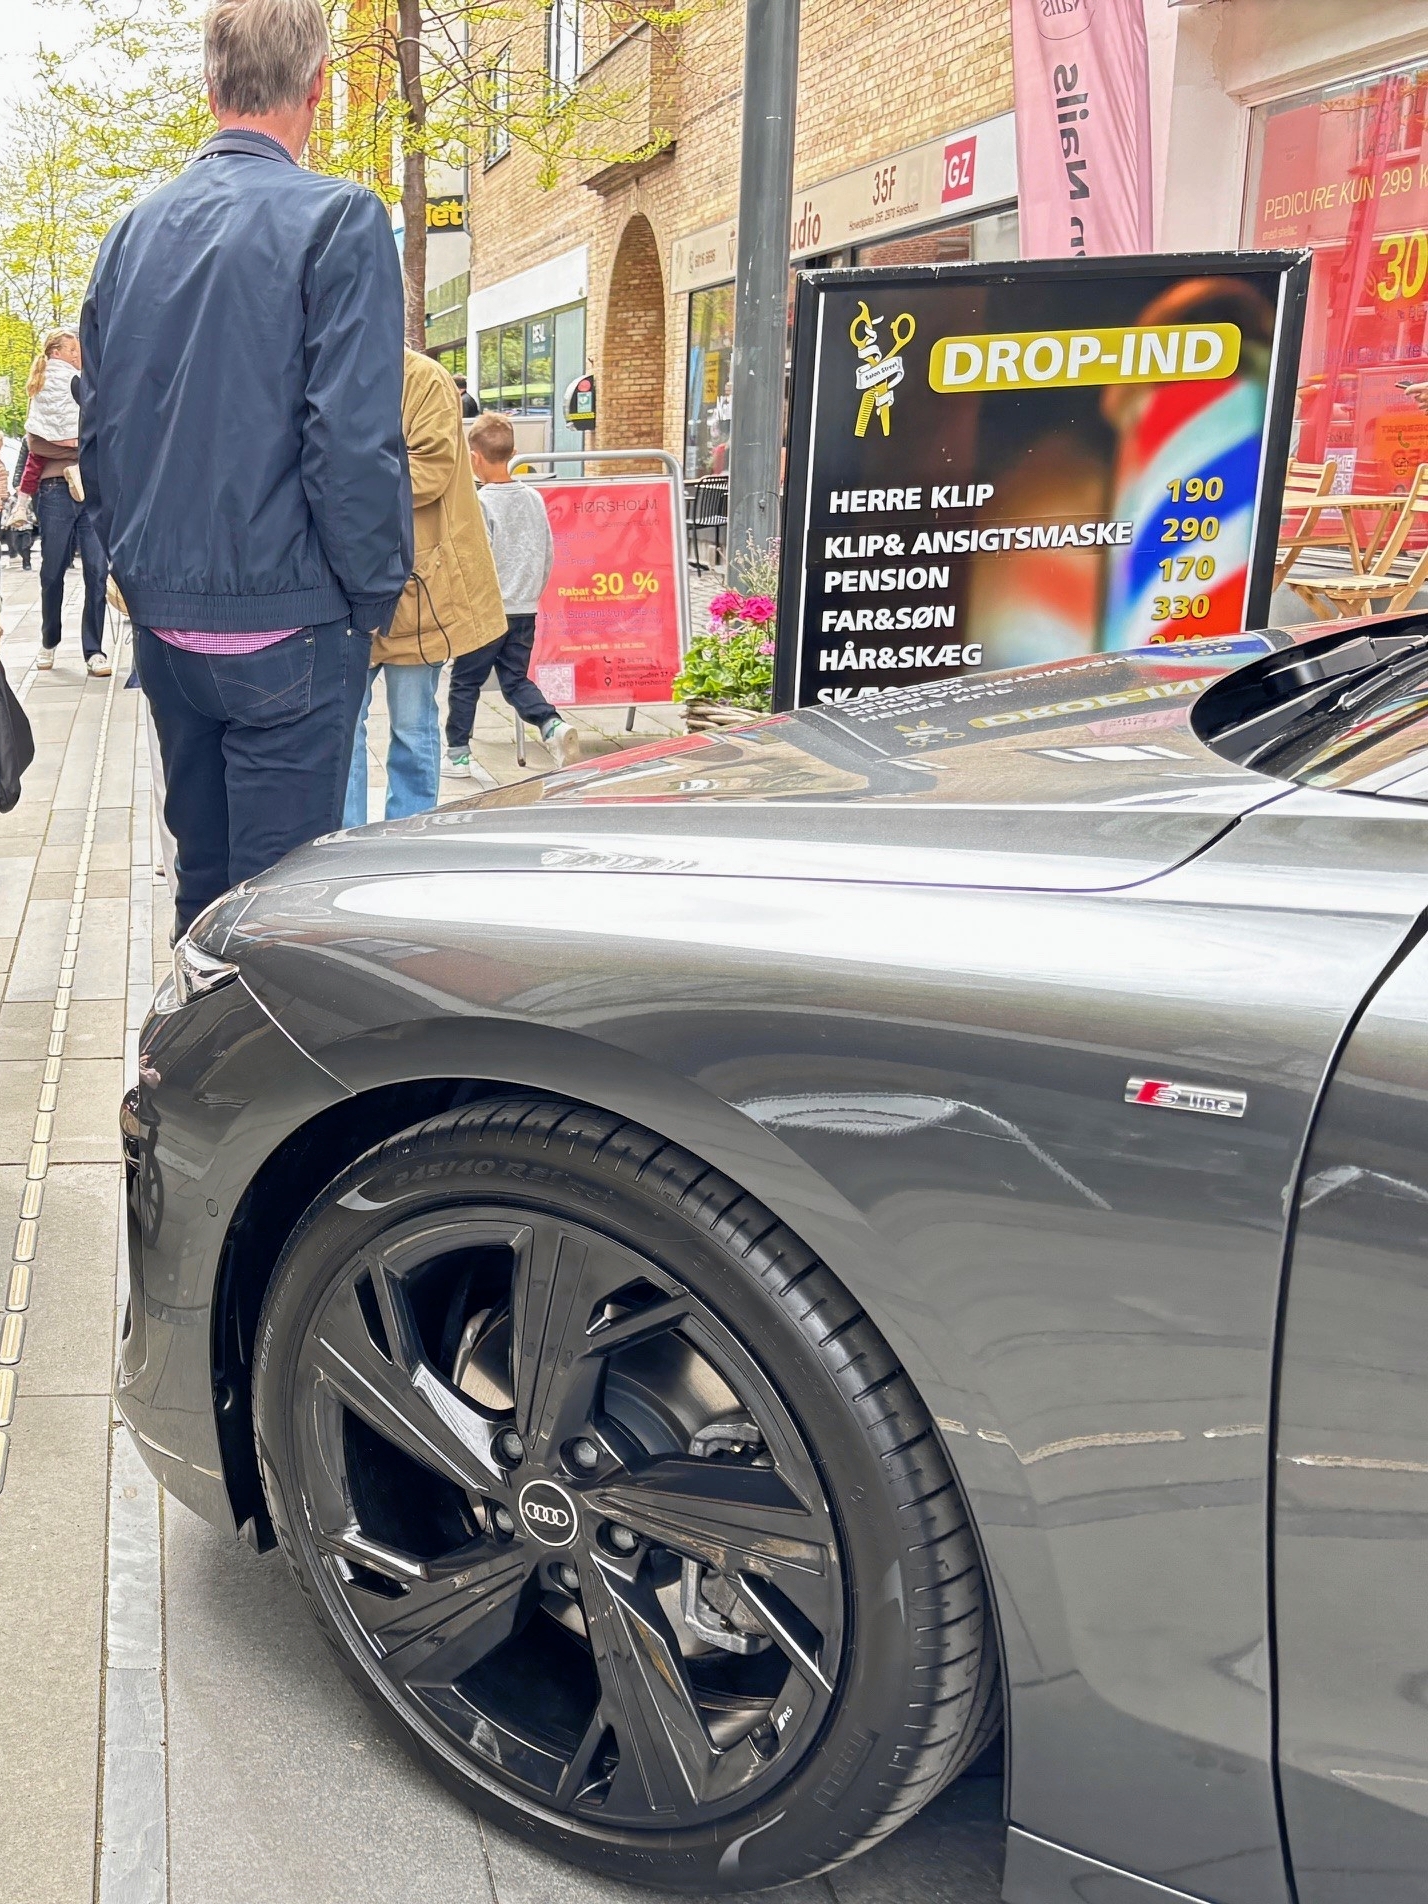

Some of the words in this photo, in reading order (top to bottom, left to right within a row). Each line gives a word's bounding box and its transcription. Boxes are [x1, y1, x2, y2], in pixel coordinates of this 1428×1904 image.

[872, 165, 897, 206] 35F
[1264, 184, 1338, 221] PEDICURE
[1339, 175, 1376, 206] KUN
[1380, 166, 1413, 197] 299
[1377, 228, 1428, 302] 30
[941, 330, 1224, 386] DROP-IND
[829, 487, 922, 514] HERRE
[930, 484, 995, 510] KLIP
[1167, 476, 1224, 503] 190
[573, 498, 658, 514] HØRSHOLM
[824, 534, 906, 559] KLIP&
[911, 521, 1133, 555] ANSIGTSMASKE
[1160, 516, 1220, 543] 290
[824, 566, 950, 594] PENSION
[1158, 554, 1216, 582] 170
[557, 586, 590, 597] Rabat
[591, 572, 624, 596] 30
[632, 570, 660, 594] %
[822, 605, 956, 632] FAR&SØN
[1150, 593, 1211, 621] 330
[818, 641, 983, 672] HÅR&SKÆG
[1188, 1093, 1232, 1113] line
